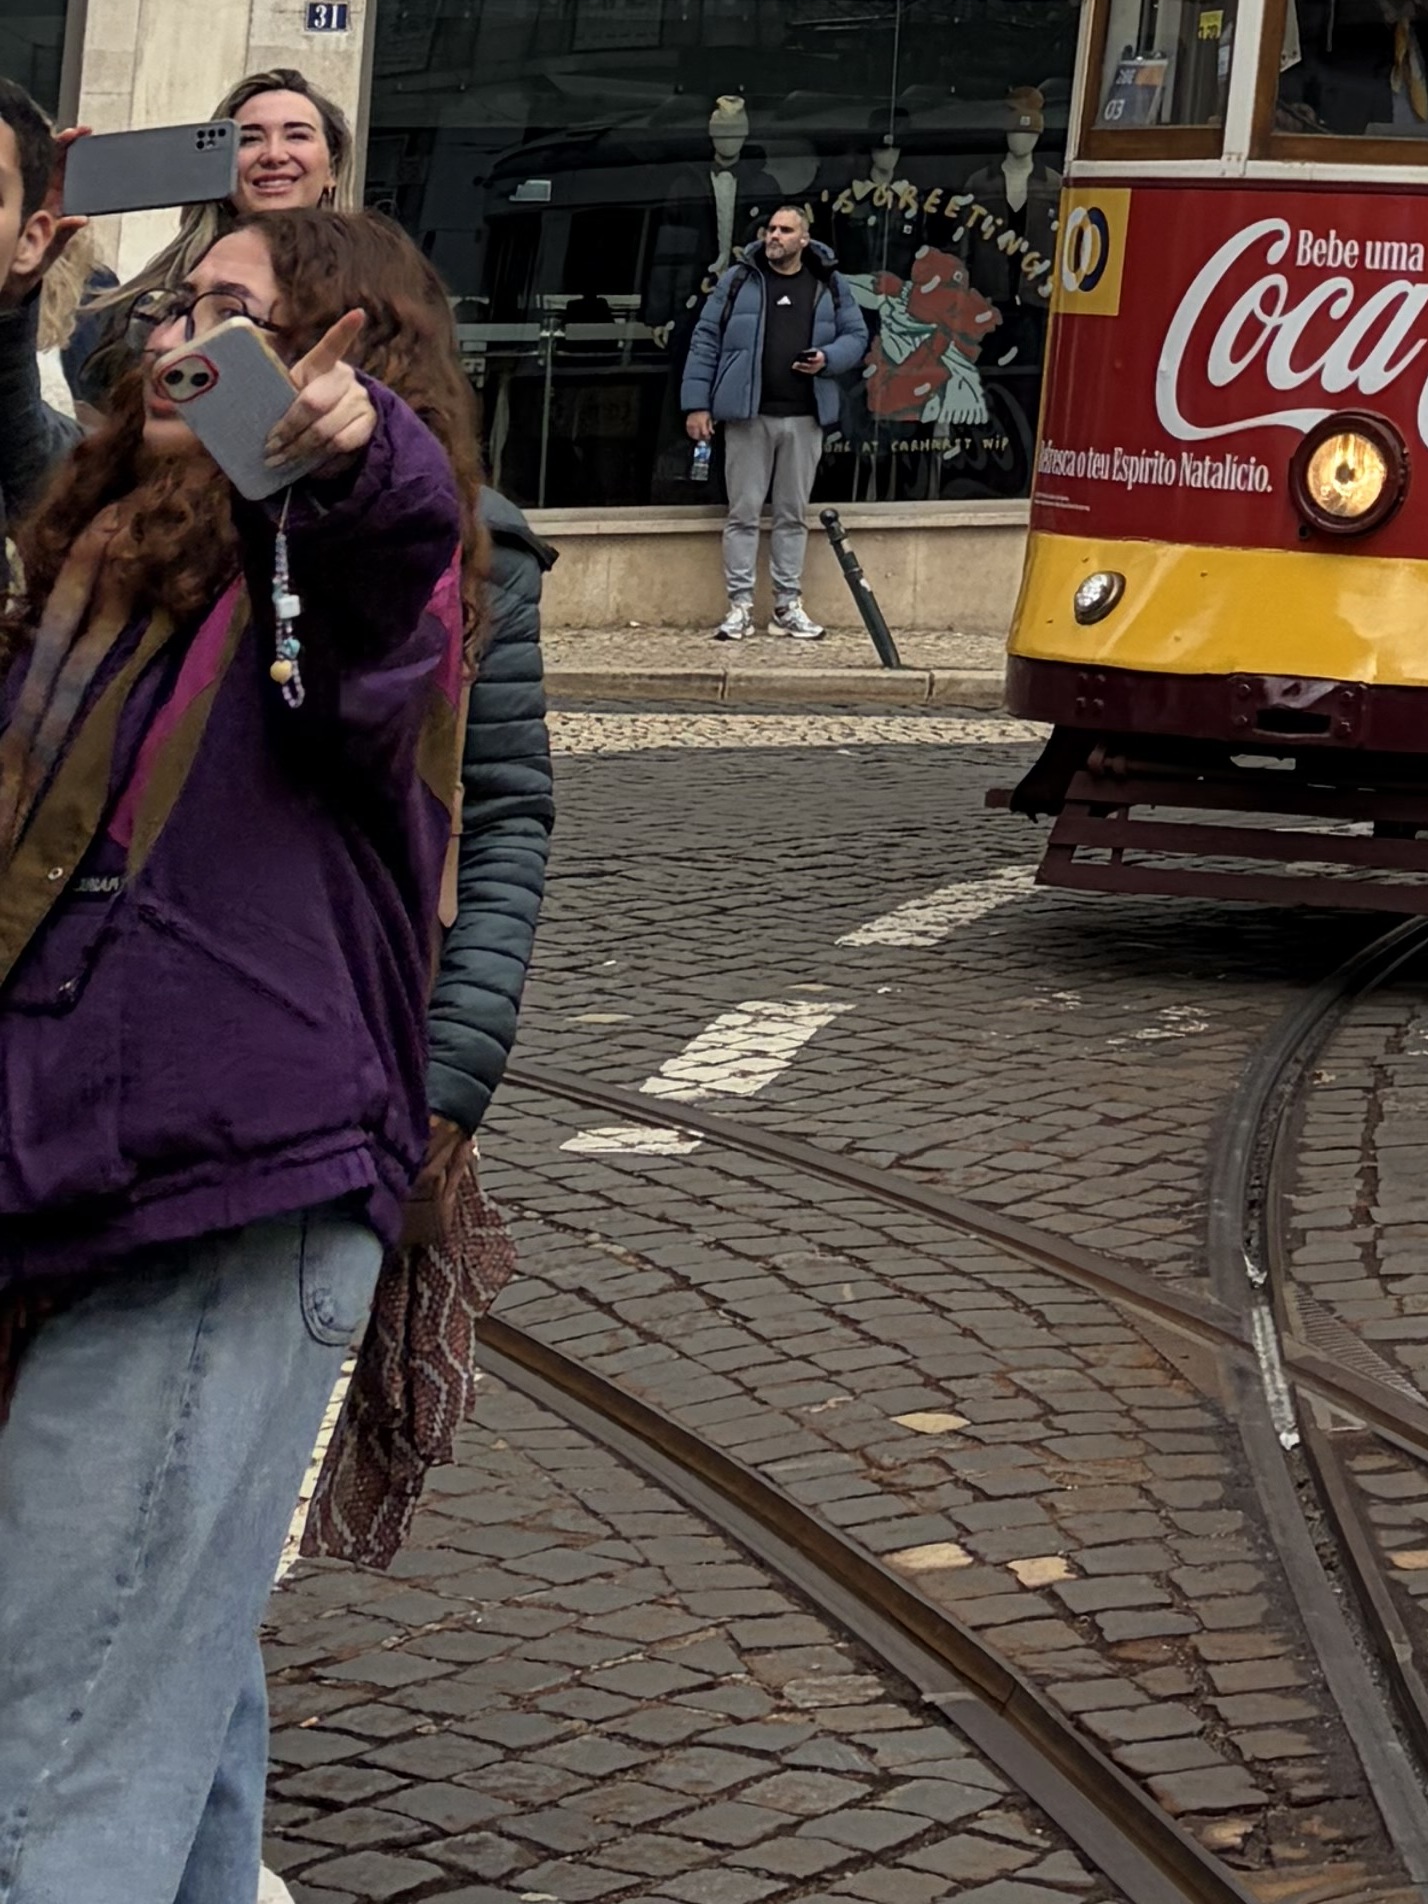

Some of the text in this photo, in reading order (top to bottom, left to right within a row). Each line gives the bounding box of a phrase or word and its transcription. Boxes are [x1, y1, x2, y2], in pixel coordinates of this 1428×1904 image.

[314, 4, 339, 29] 31
[1104, 99, 1126, 121] 03
[1296, 229, 1425, 272] Bebe uma
[1077, 456, 1085, 478] o
[1087, 447, 1110, 480] teu
[1112, 447, 1176, 490] Espírito
[1179, 452, 1273, 493] Natalício.
